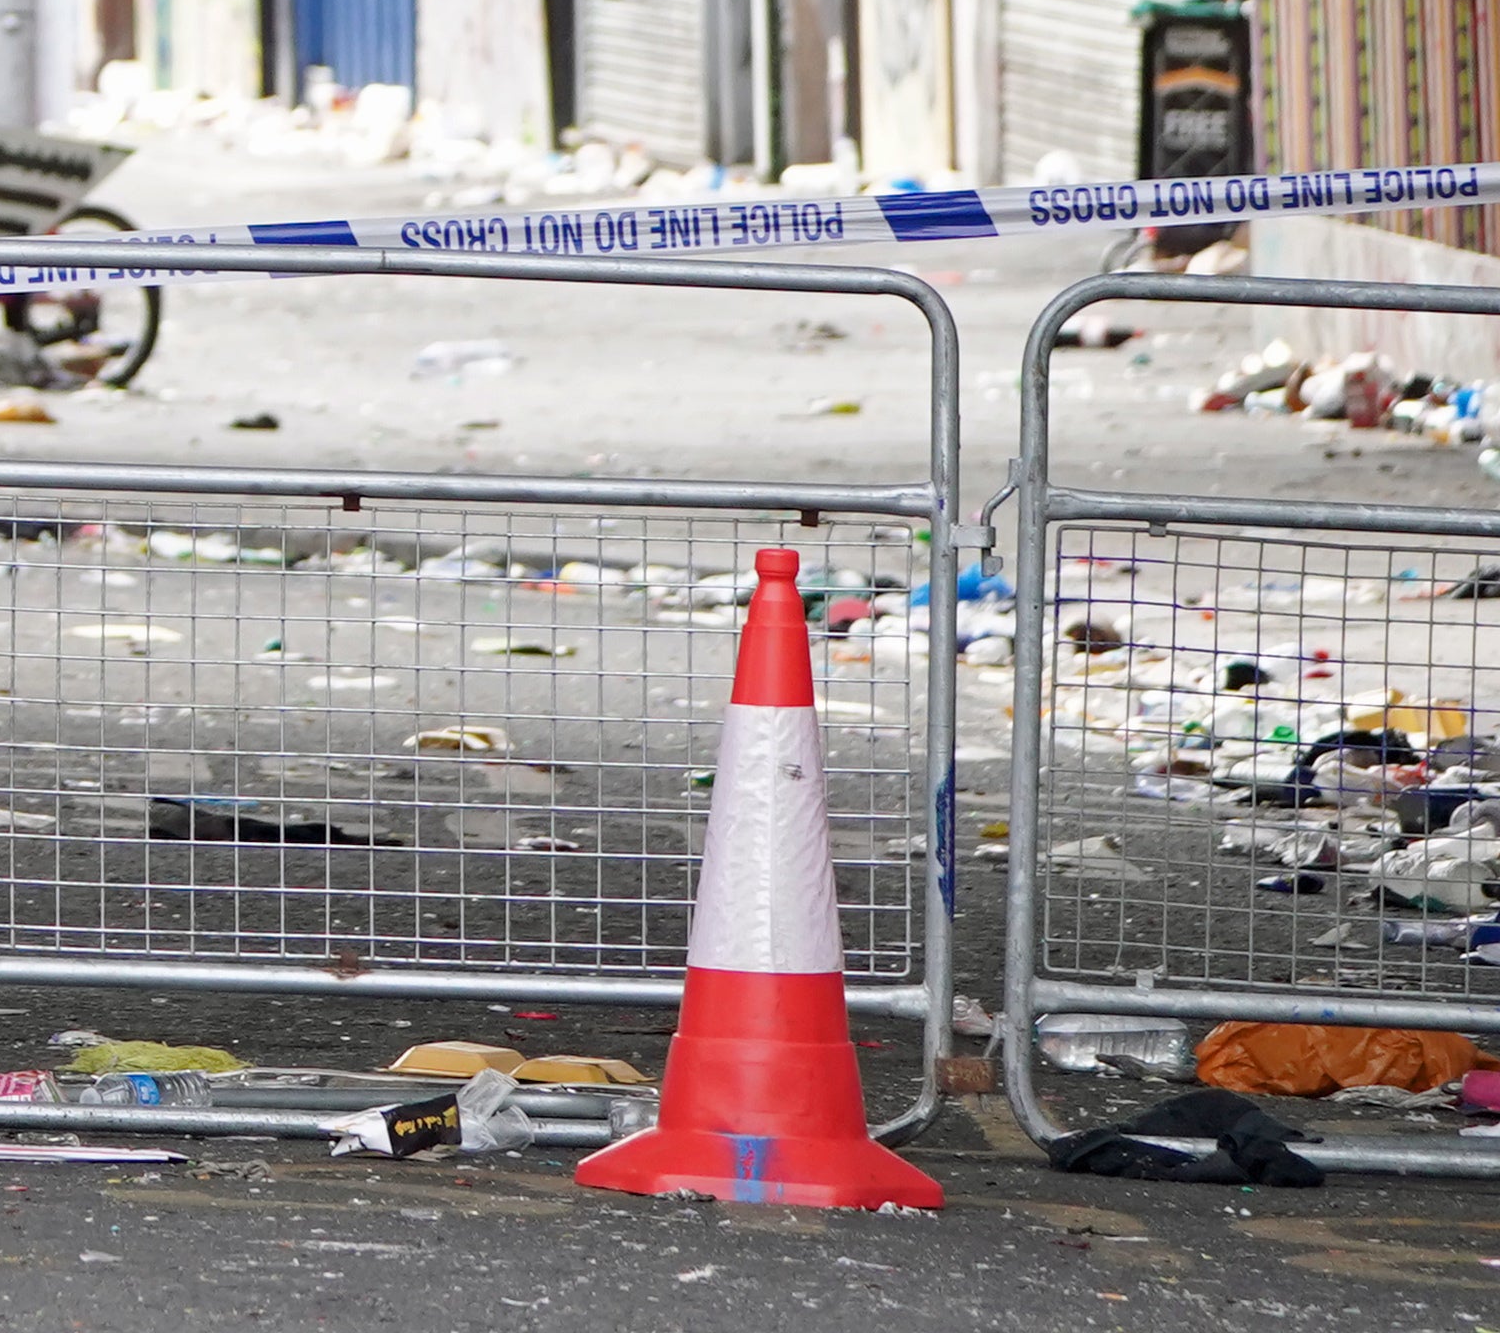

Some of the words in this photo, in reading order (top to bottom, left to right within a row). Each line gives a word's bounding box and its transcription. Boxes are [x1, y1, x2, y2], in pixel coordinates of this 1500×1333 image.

[1028, 184, 1139, 227] CROSS
[1150, 180, 1214, 218] NOT
[1224, 177, 1271, 212] DO
[1281, 172, 1352, 209] LINE
[1362, 166, 1480, 205] POLICE
[400, 218, 508, 252] CROSS
[521, 213, 584, 255] NOT
[596, 211, 638, 253] DO
[648, 208, 719, 250] LINE
[730, 201, 844, 244] POLICE
